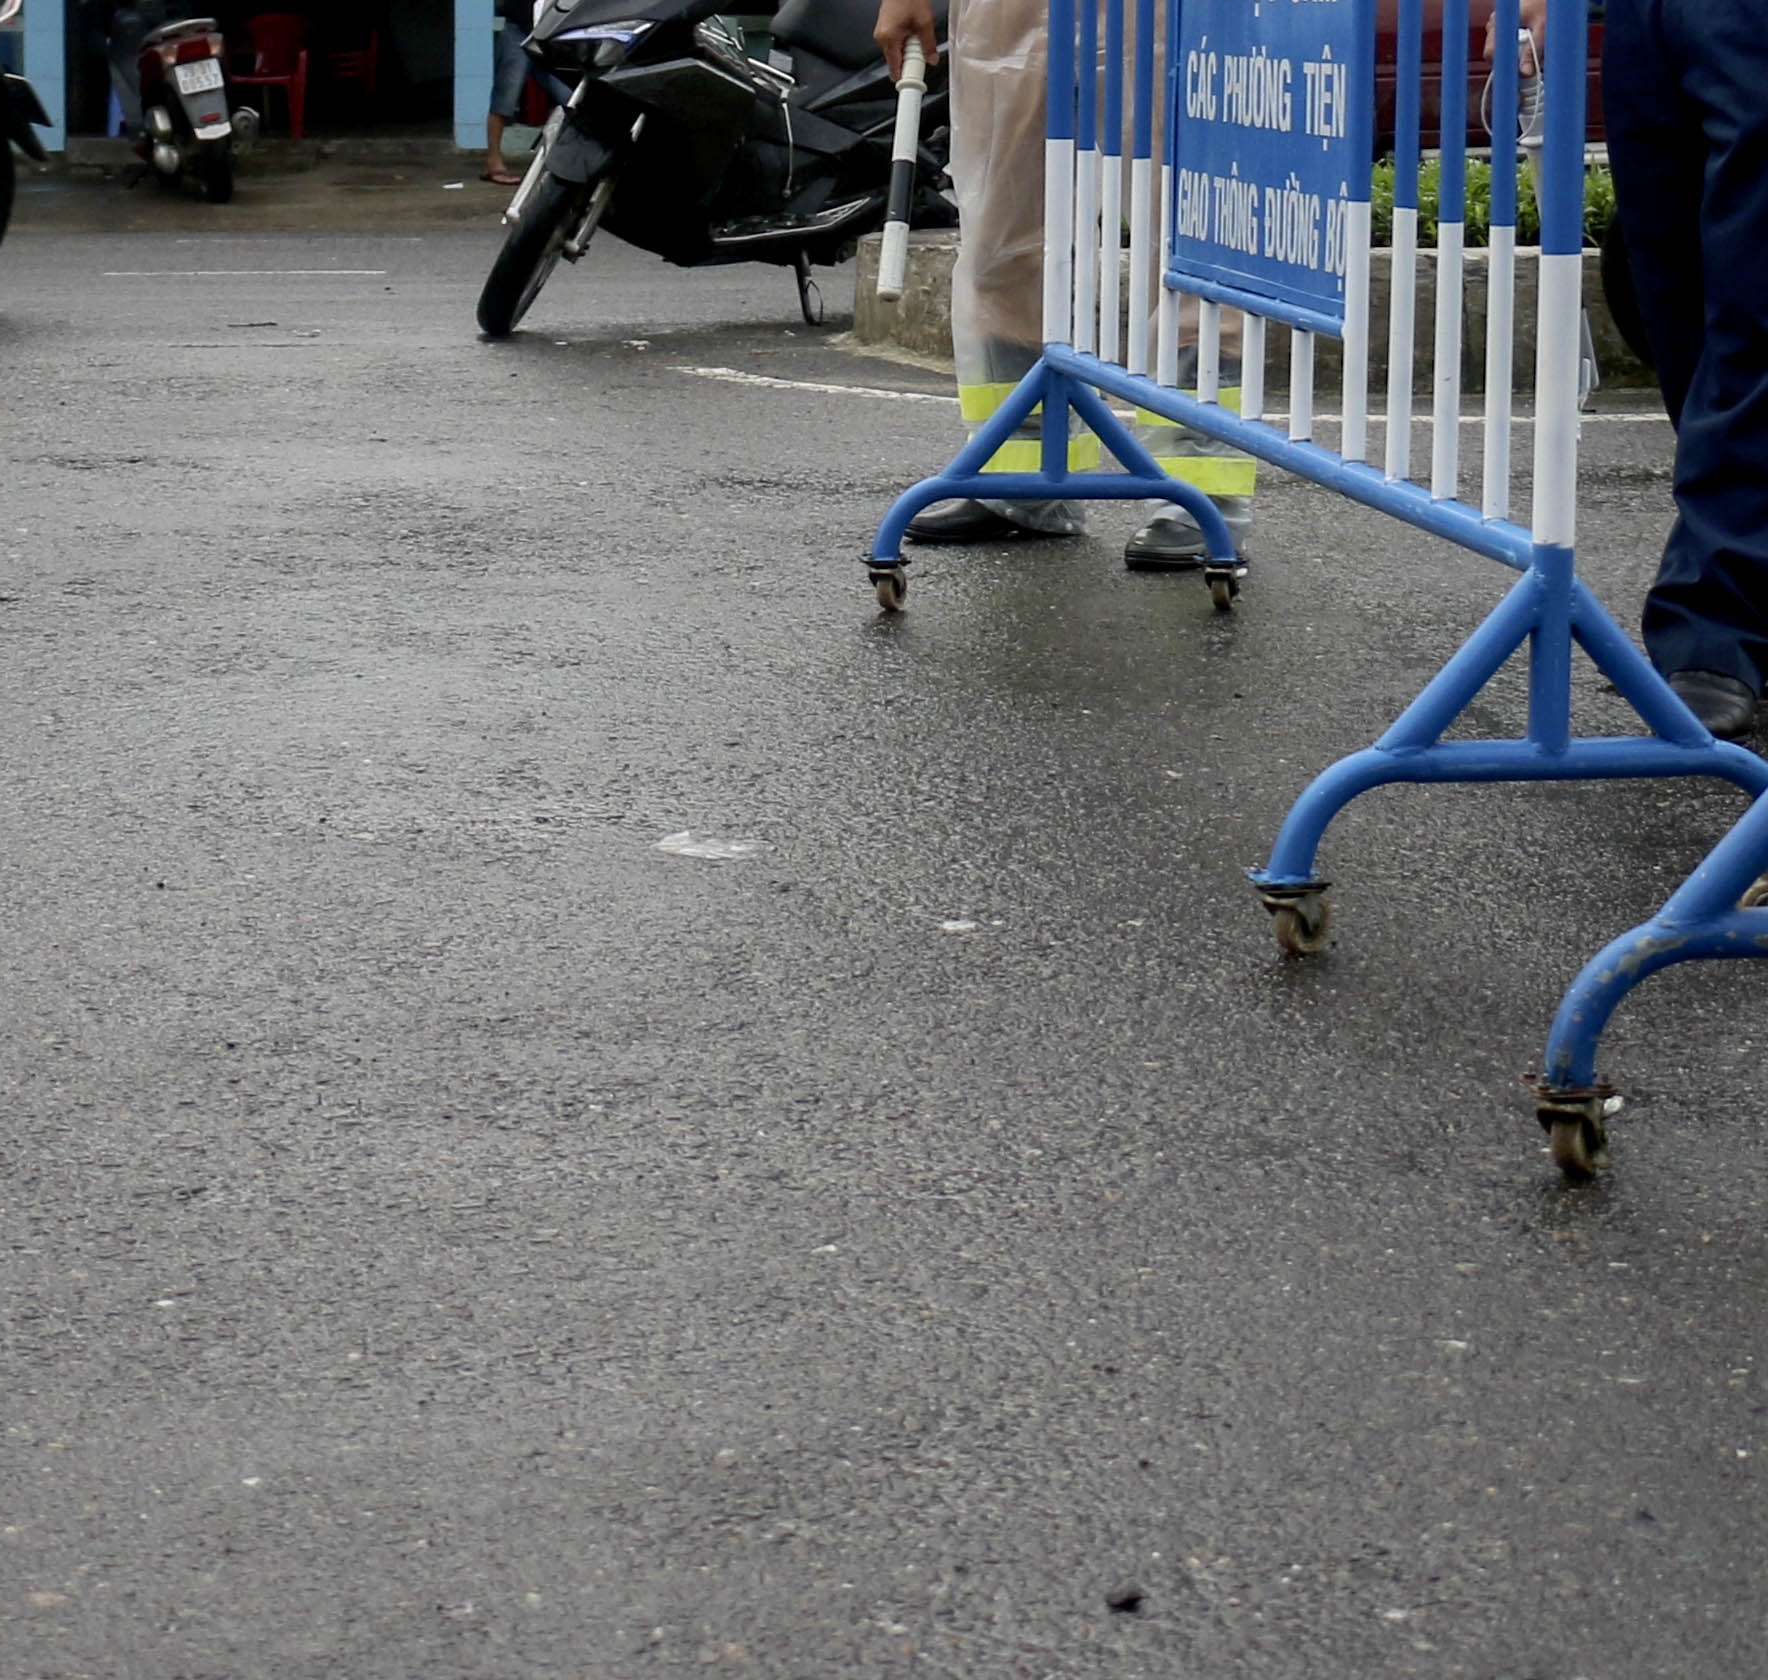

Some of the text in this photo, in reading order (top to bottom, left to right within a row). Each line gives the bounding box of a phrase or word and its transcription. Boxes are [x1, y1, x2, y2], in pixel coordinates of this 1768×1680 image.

[1187, 36, 1346, 151] CÁC PHƯƠNG TIỆN
[1179, 162, 1347, 292] GIAO THÔNG ĐƯỜNG BỘ
